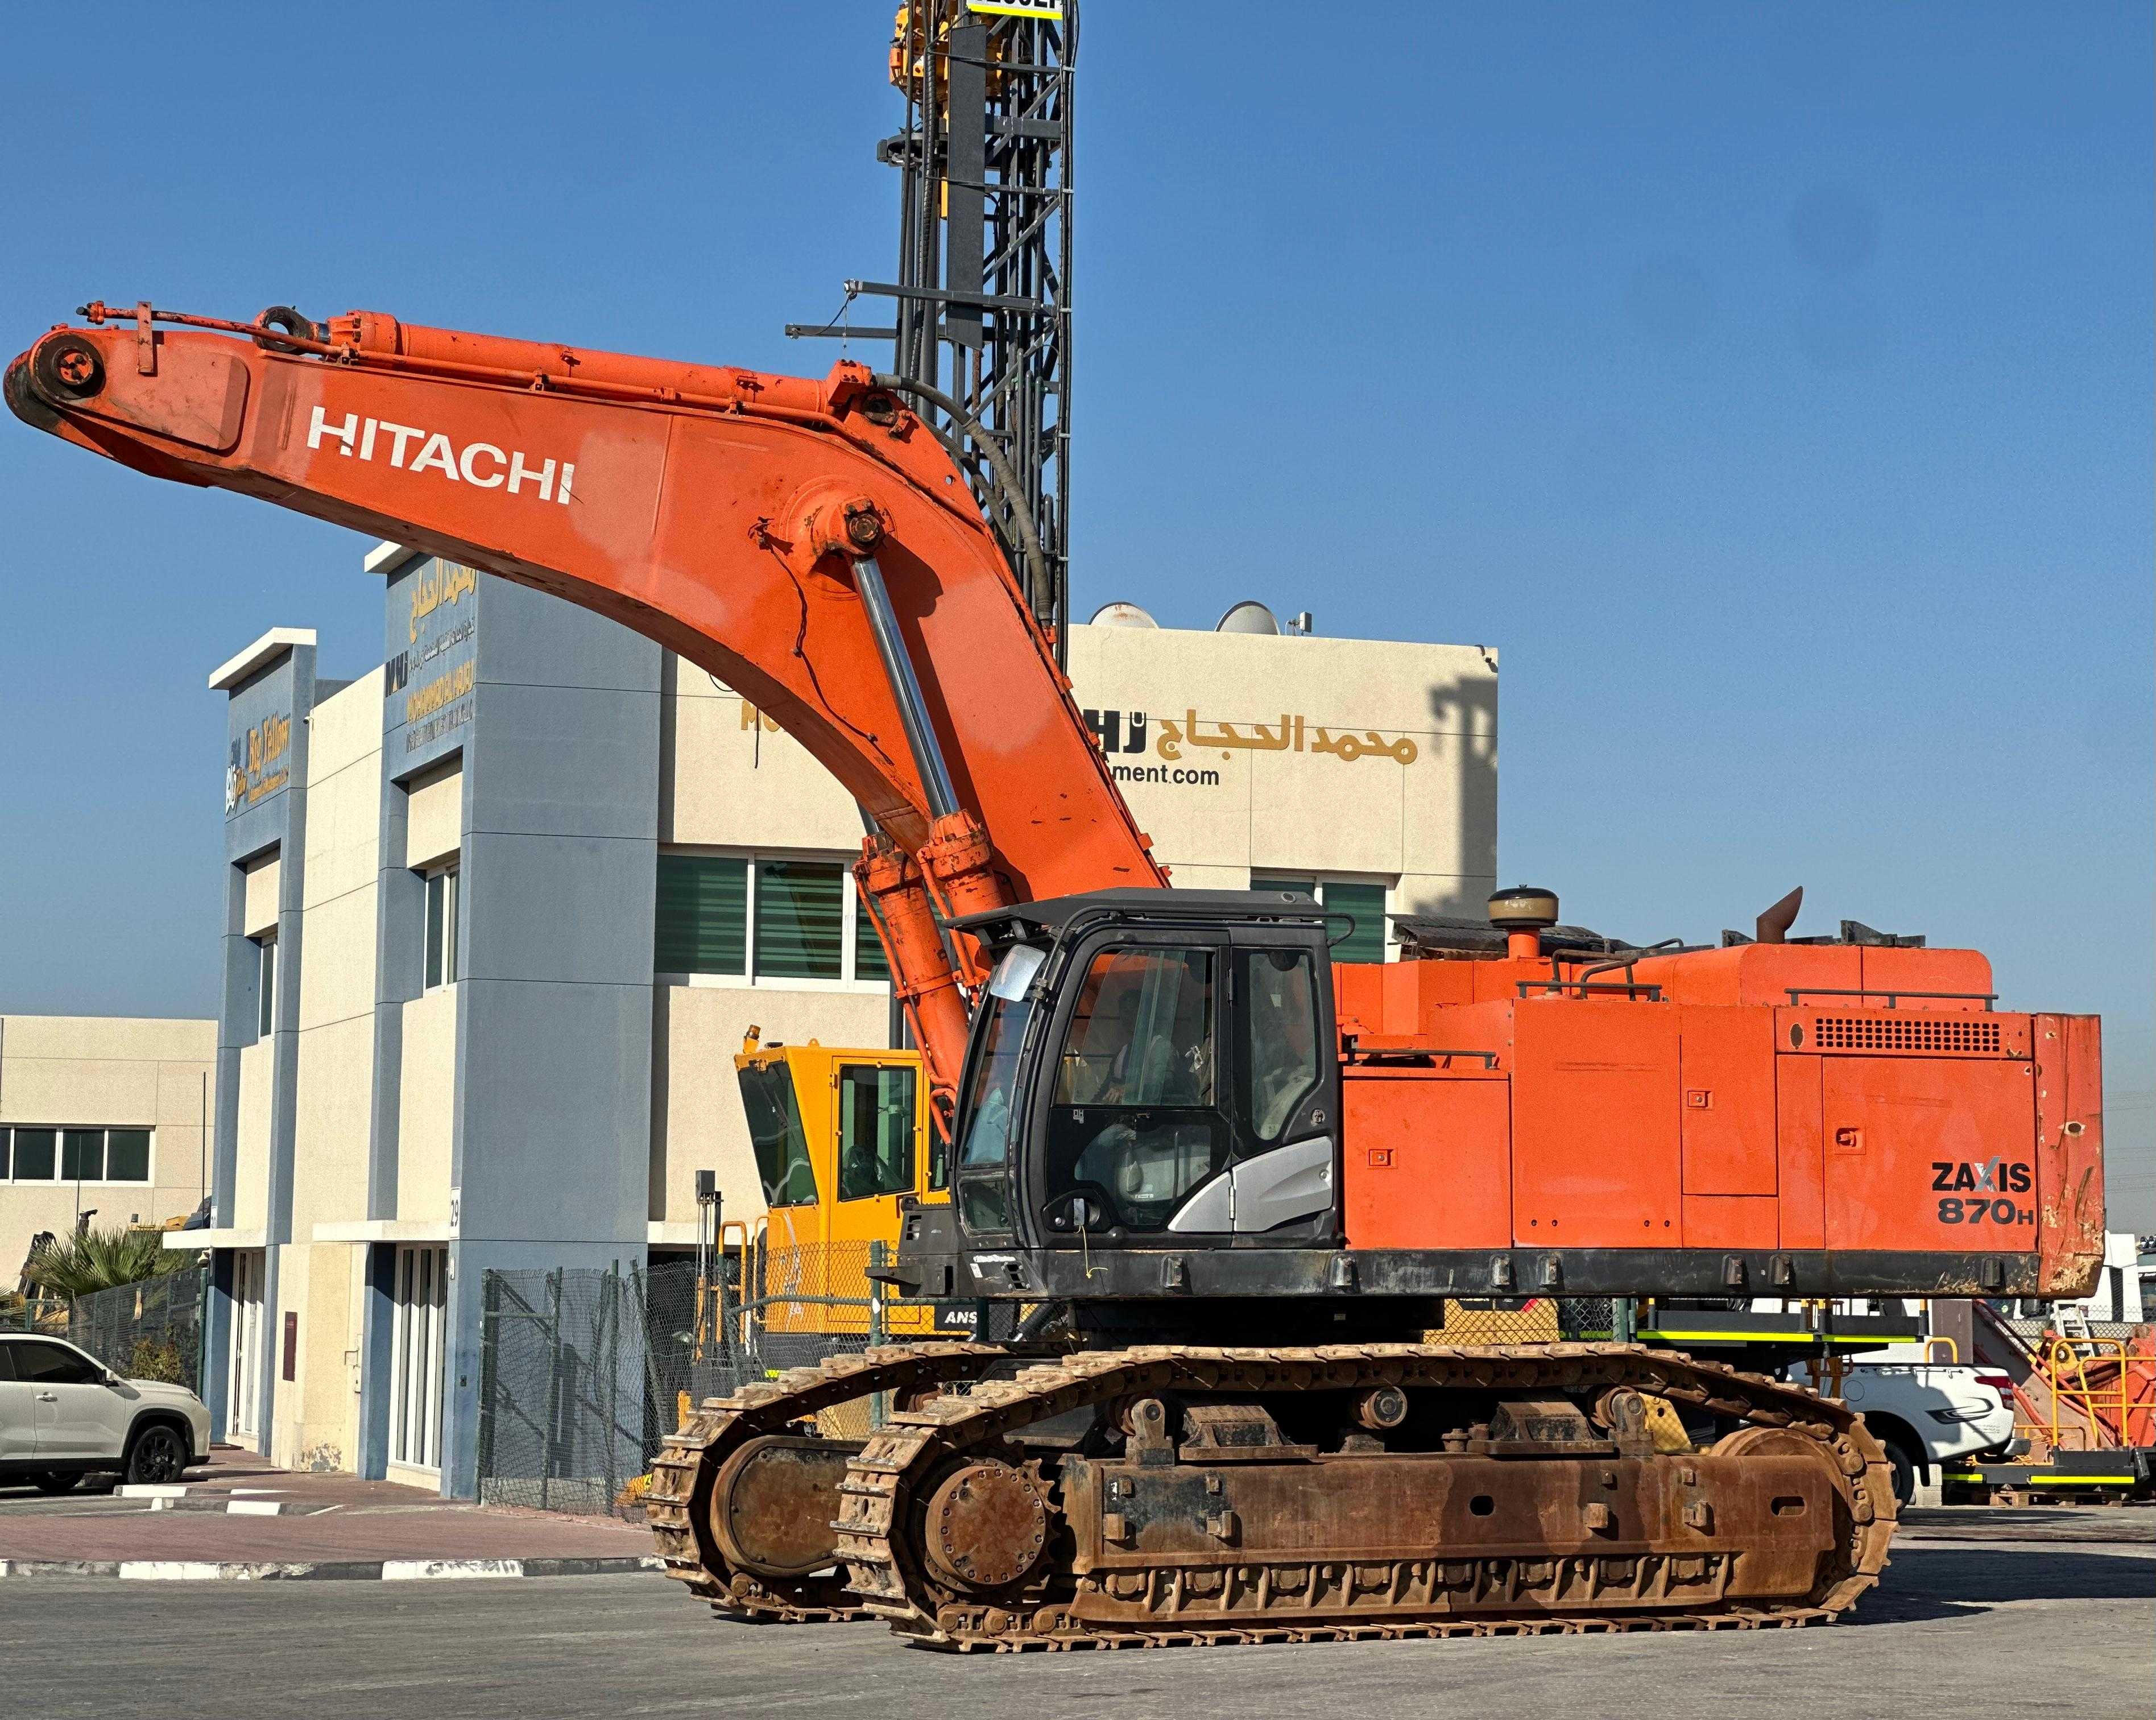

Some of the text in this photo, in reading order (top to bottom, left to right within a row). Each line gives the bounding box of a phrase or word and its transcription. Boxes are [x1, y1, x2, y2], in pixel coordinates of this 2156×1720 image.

[307, 406, 575, 505] HITACHI
[248, 715, 291, 781] Big Yellow
[1157, 709, 1418, 765] محمد الحجاج
[1932, 1156, 2031, 1193] ZAXIS
[450, 1200, 459, 1227] 29
[1938, 1198, 2034, 1225] 870H
